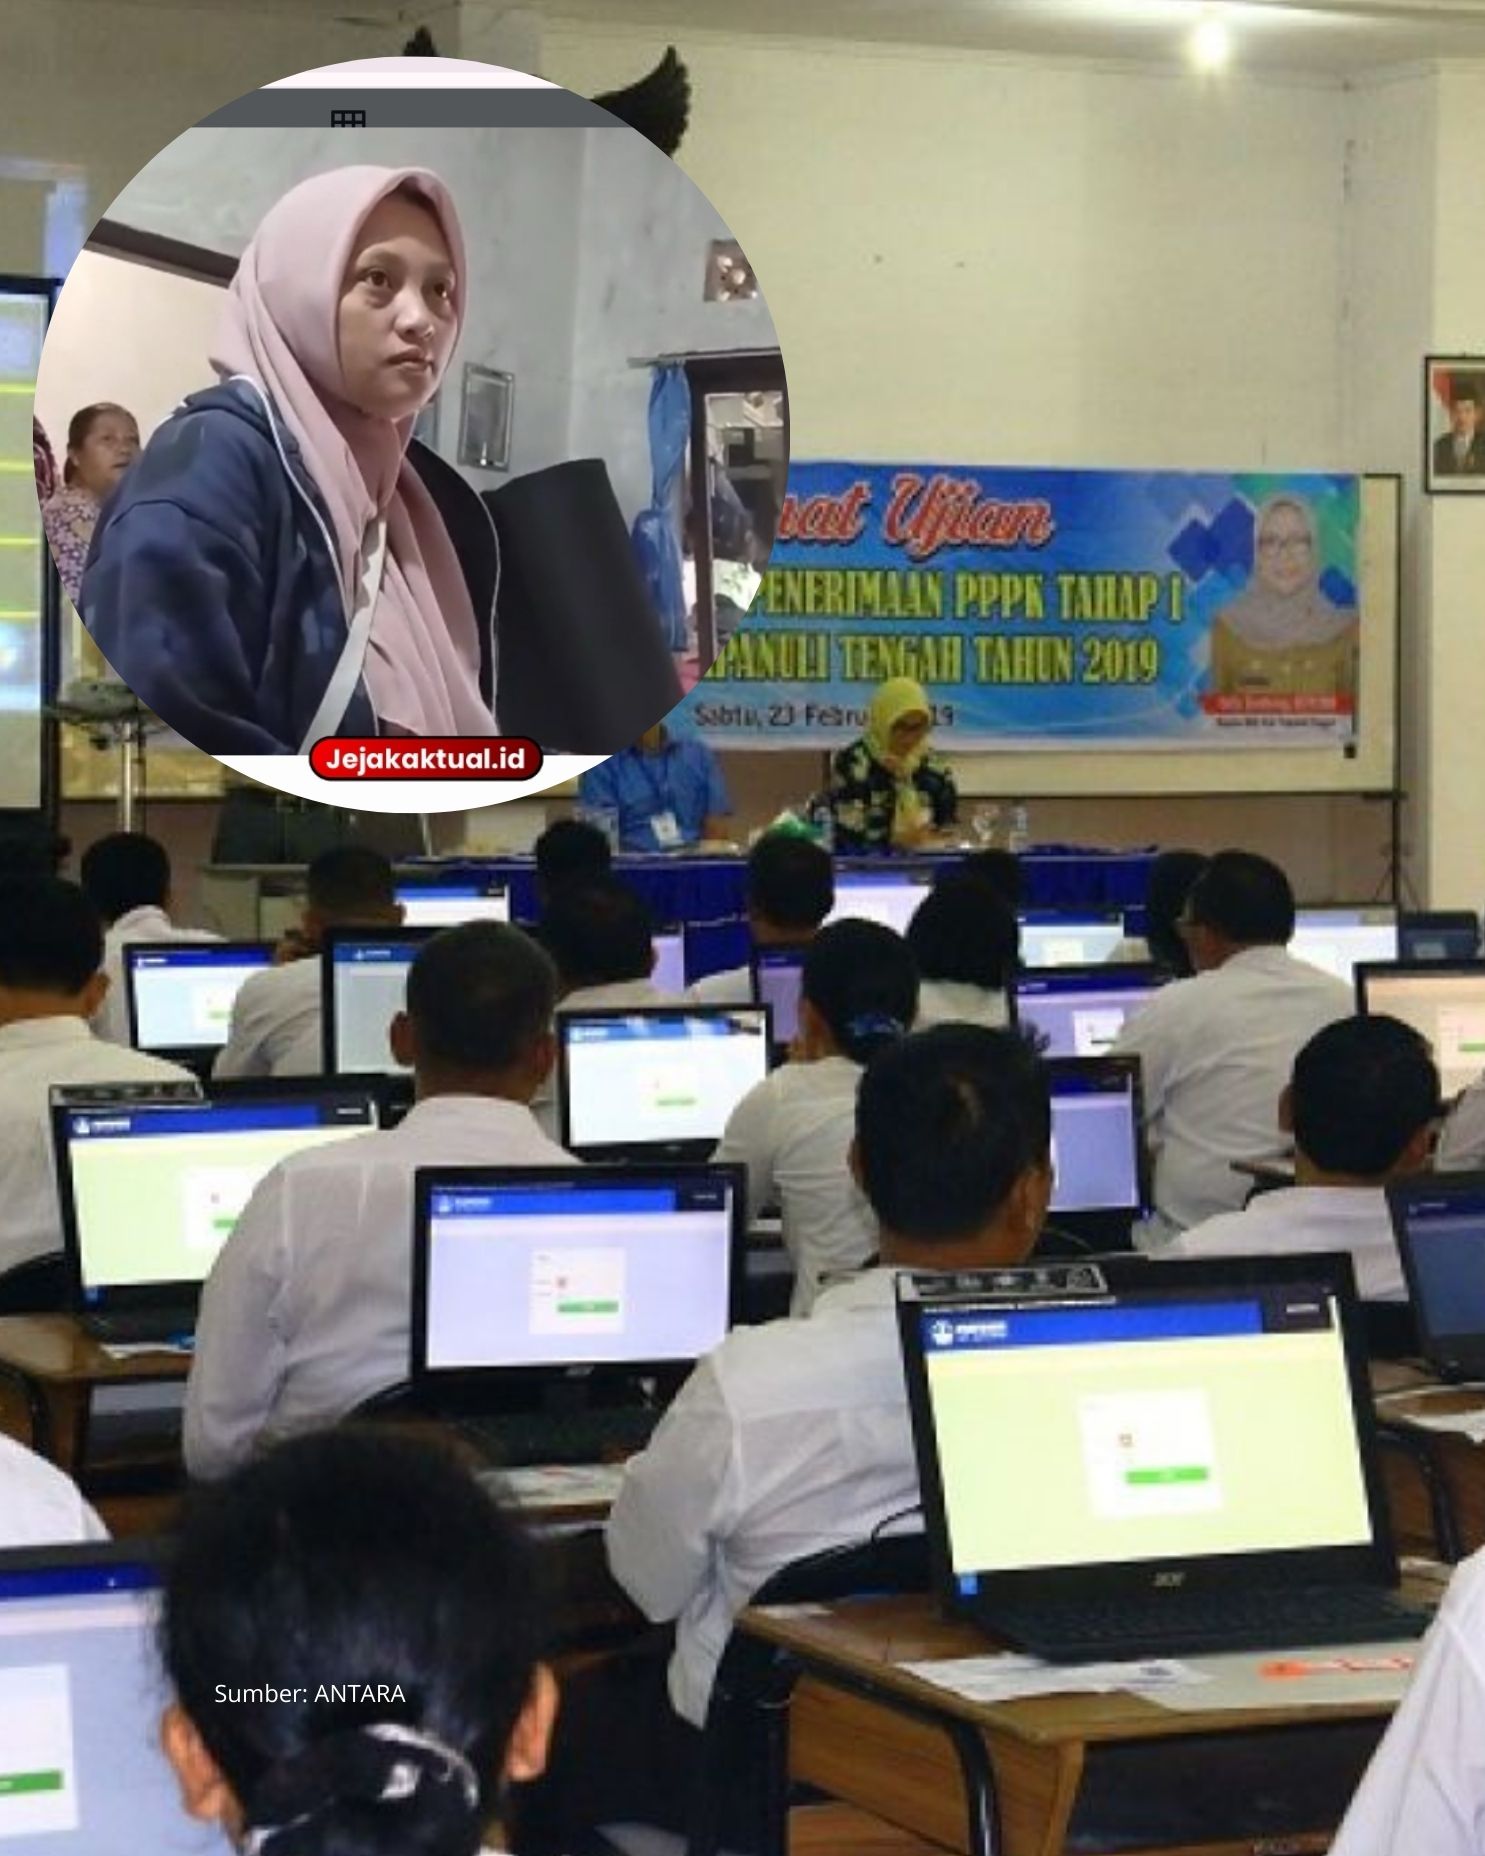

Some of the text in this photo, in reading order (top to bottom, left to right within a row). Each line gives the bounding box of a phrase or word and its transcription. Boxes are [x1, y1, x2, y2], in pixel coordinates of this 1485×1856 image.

[779, 473, 1056, 560] at Ujian
[954, 571, 1045, 619] PPPK
[1057, 573, 1158, 621] TAHAP
[1168, 573, 1184, 621] I
[840, 635, 963, 683] TENGAH
[974, 636, 1075, 684] TAHUN
[1082, 637, 1158, 684] 2019
[694, 705, 763, 729] Sabtu,
[805, 705, 869, 727] Febru
[931, 704, 954, 727] 19
